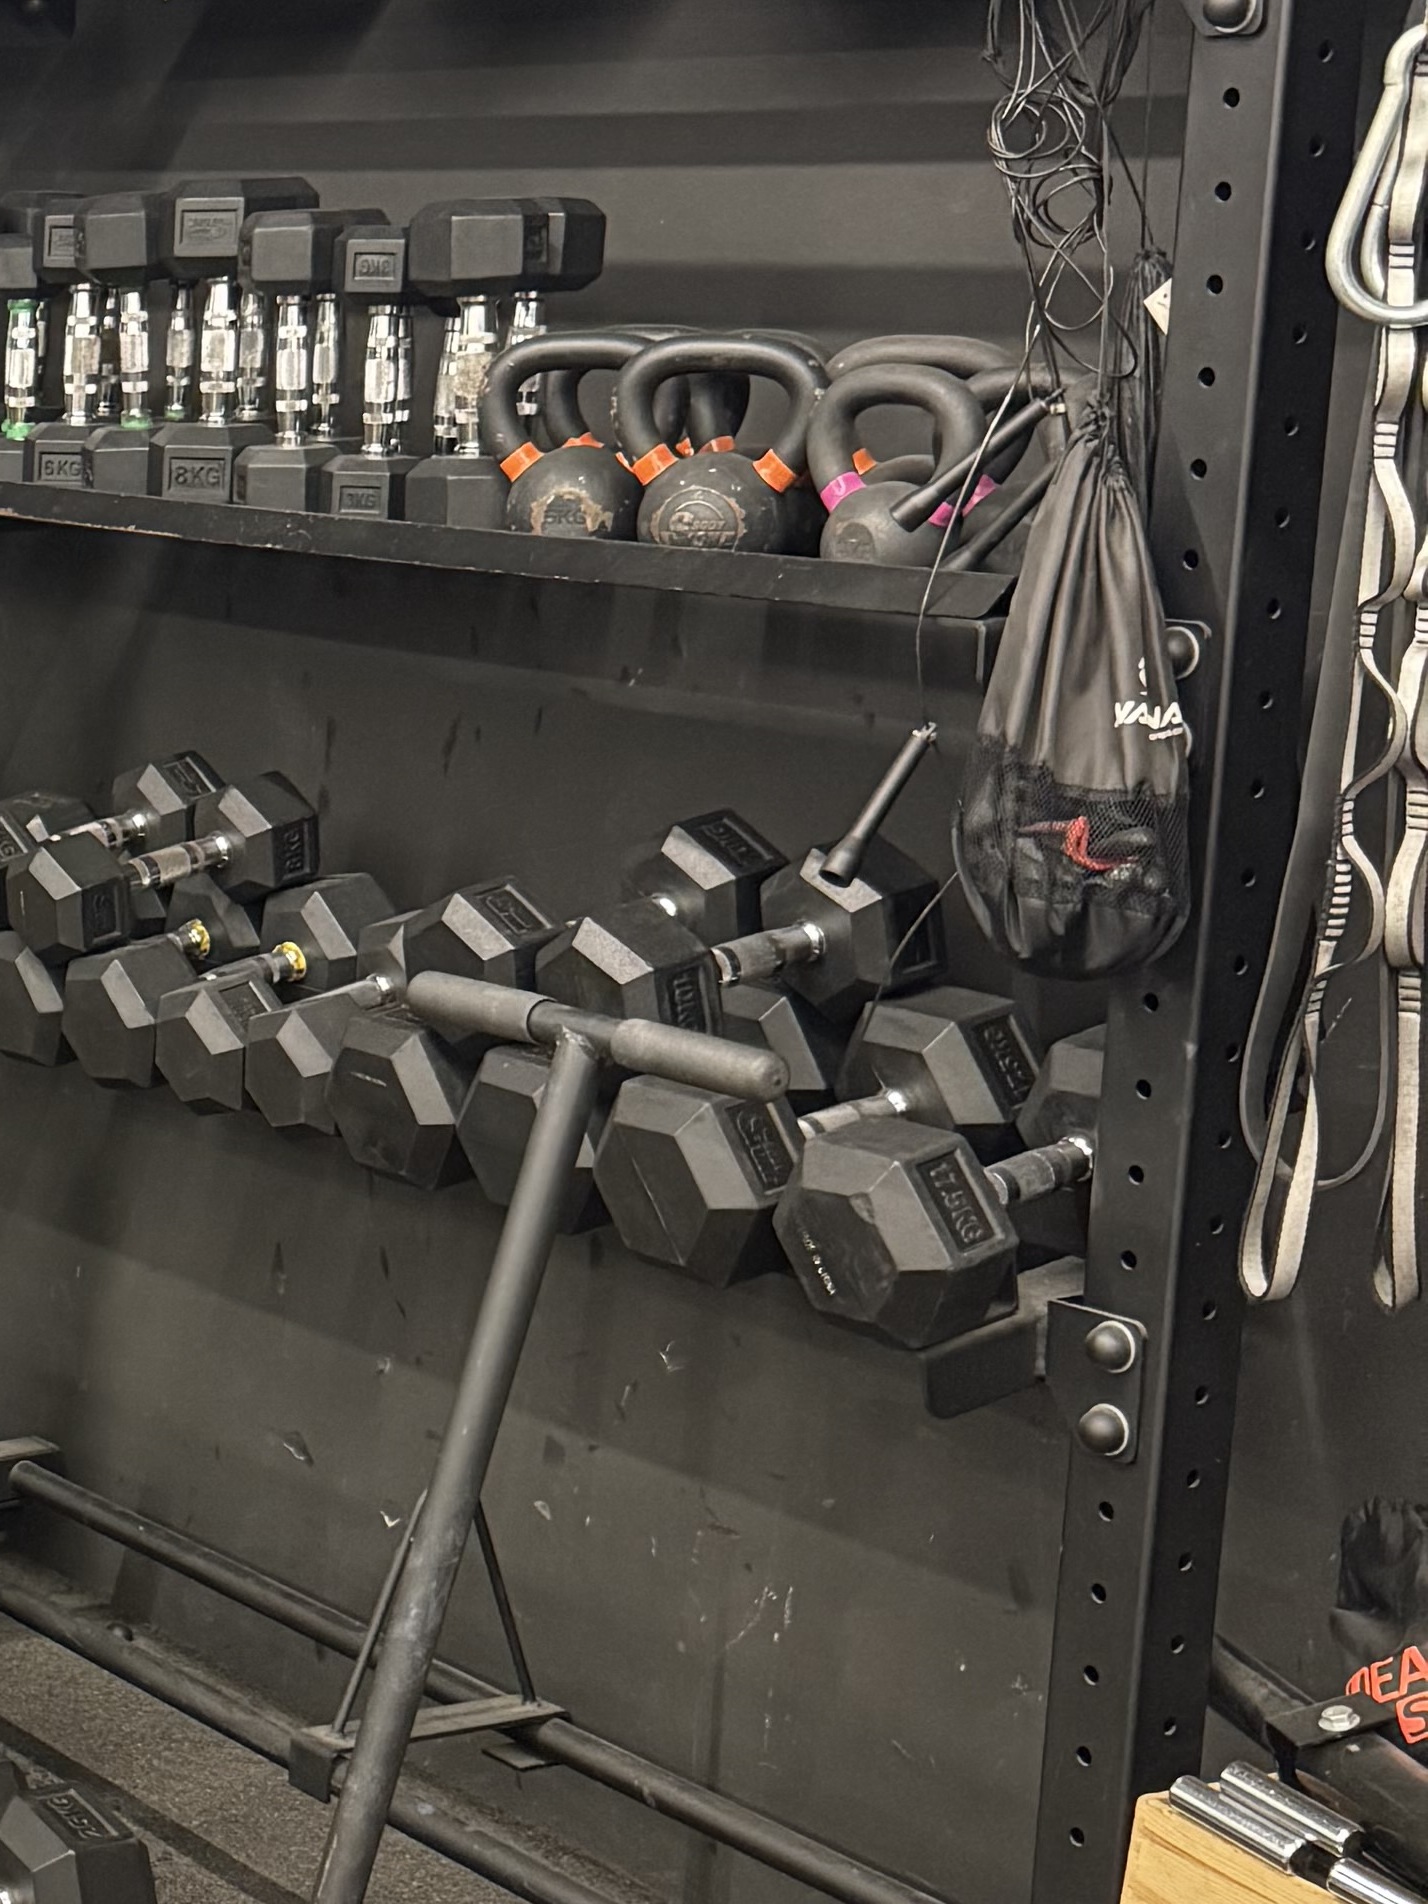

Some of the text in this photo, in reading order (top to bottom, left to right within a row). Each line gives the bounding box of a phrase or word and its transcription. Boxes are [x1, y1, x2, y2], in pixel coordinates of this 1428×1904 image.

[43, 458, 83, 478] 6KG
[173, 462, 222, 487] 8KG
[671, 969, 700, 1033] 10K
[929, 1162, 983, 1244] 17.5KG
